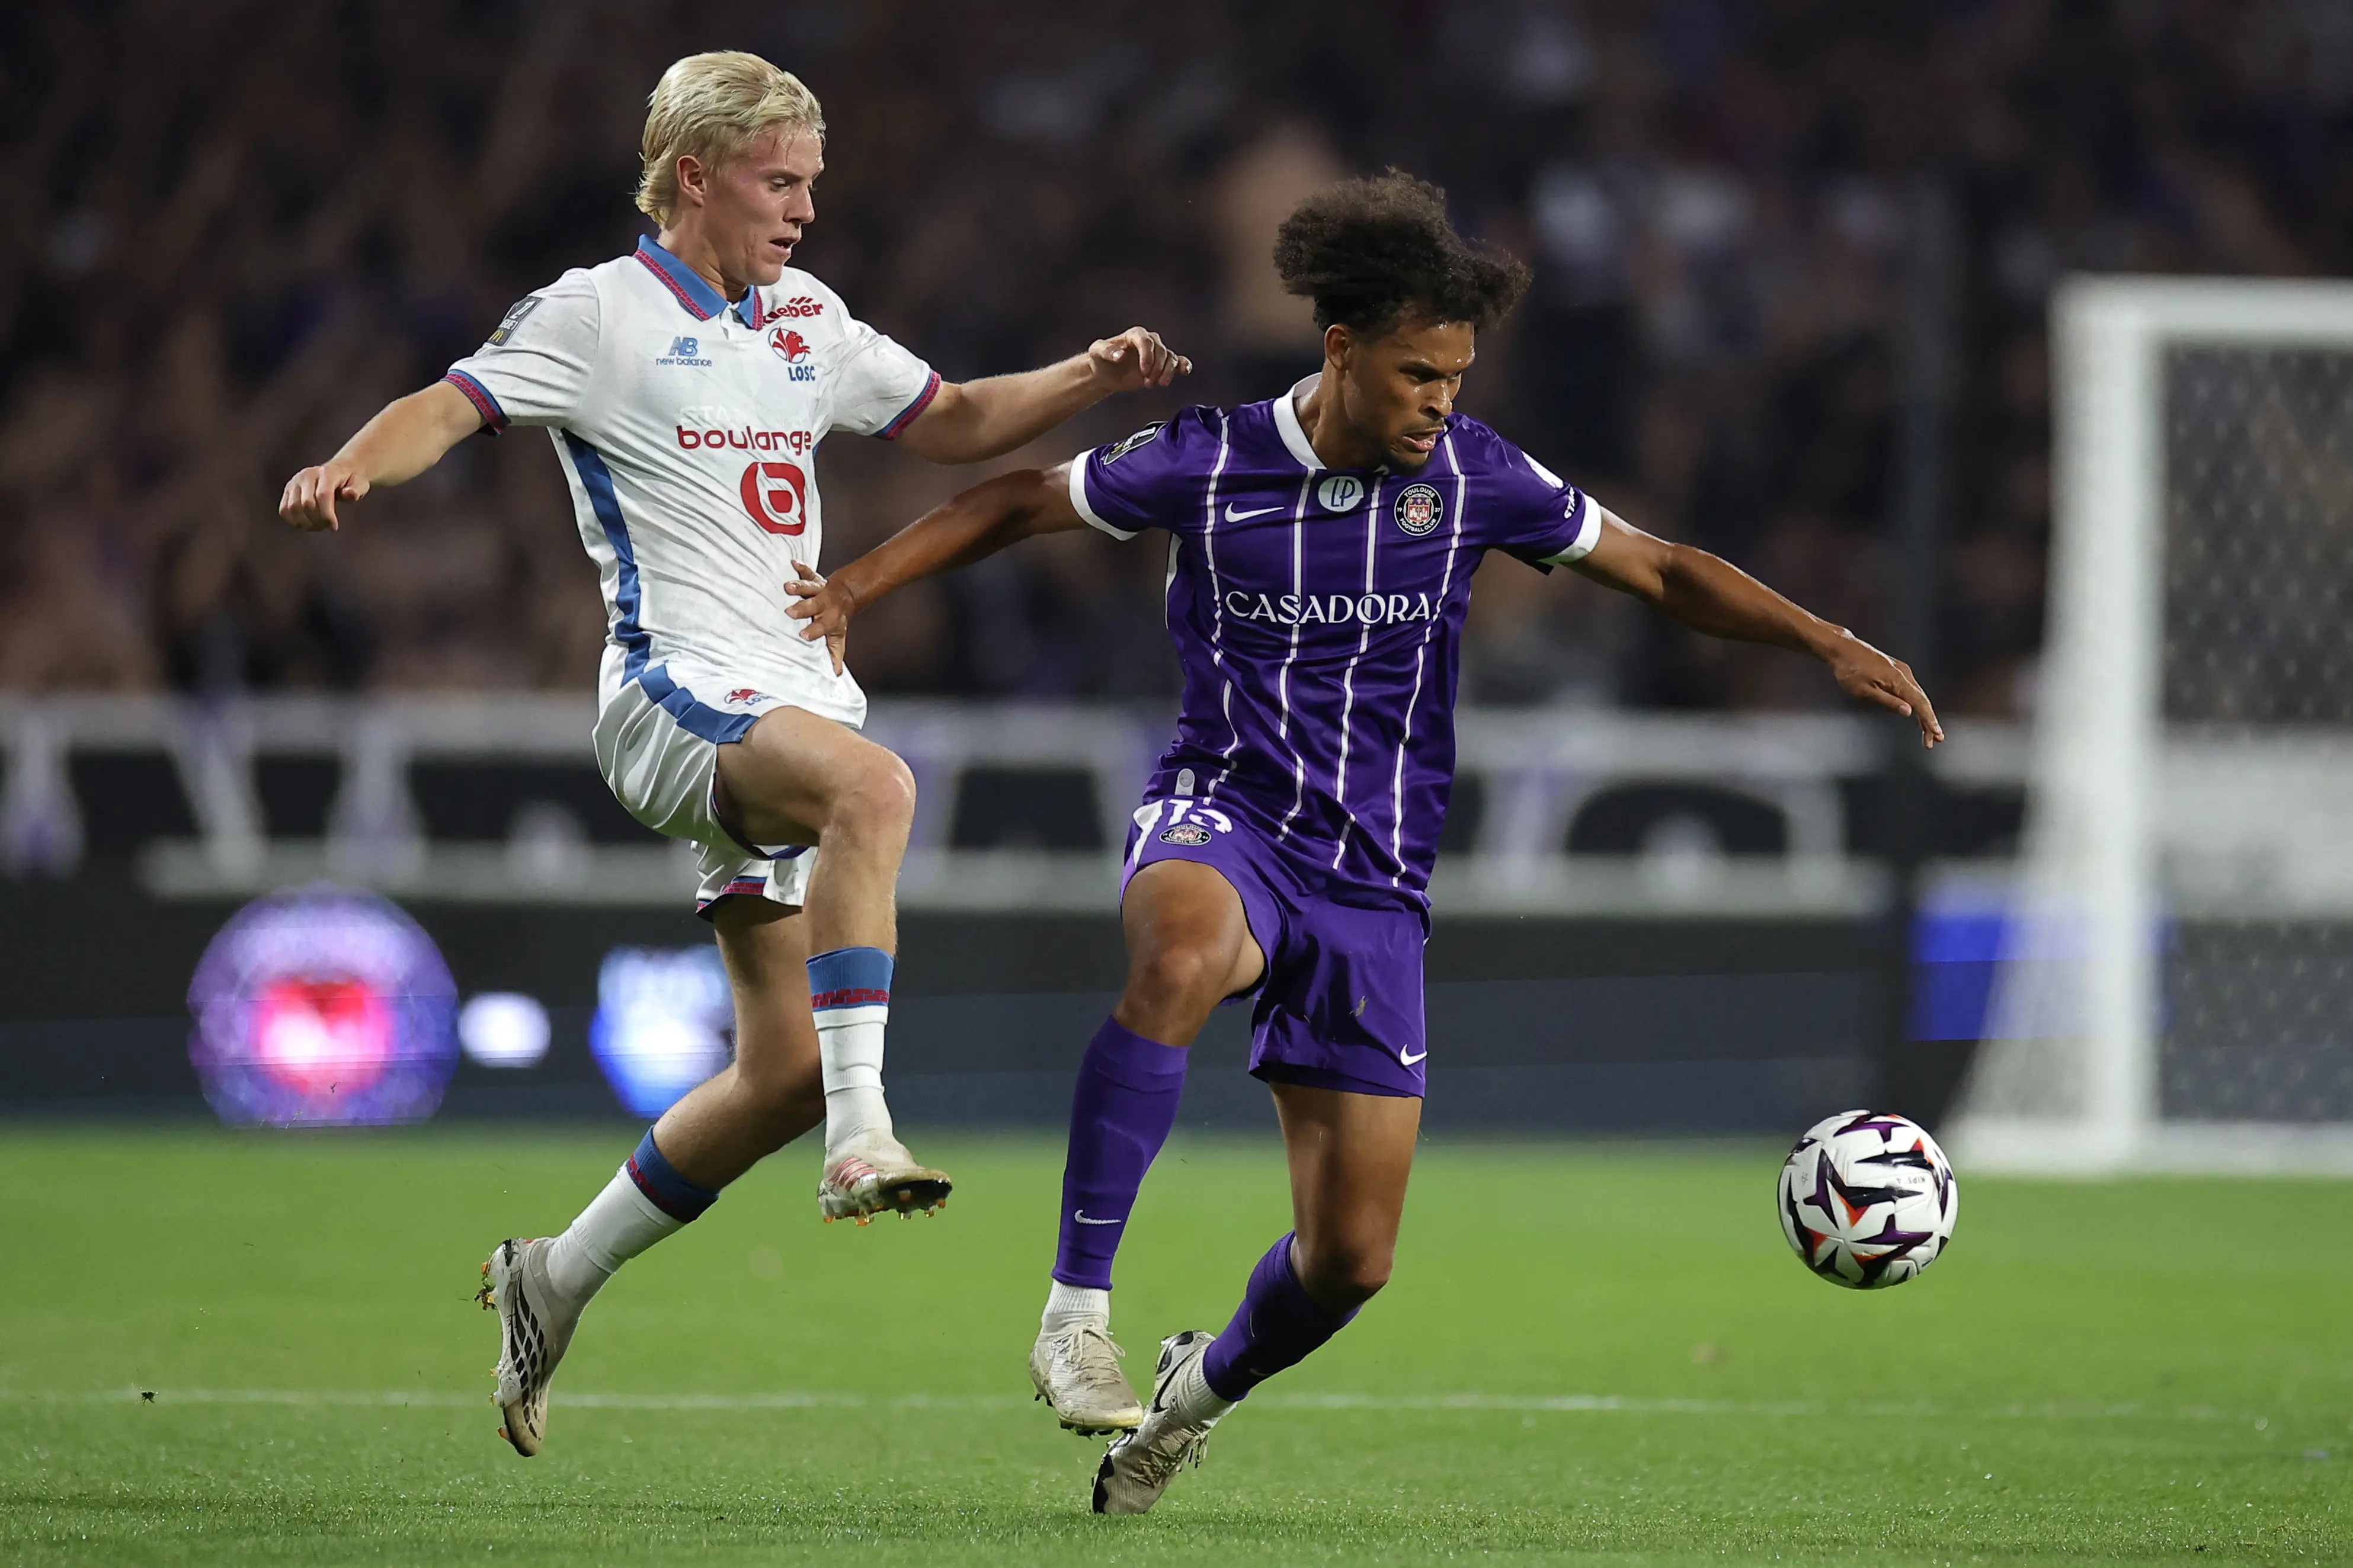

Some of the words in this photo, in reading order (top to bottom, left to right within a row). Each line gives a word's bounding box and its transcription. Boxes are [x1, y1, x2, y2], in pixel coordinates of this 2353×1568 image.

[668, 336, 697, 357] NB
[676, 356, 712, 367] balance
[787, 365, 815, 381] LOSC
[1331, 478, 1355, 506] LP
[1404, 487, 1435, 498] TOULOUSE
[1400, 518, 1424, 533] FOOTBALL
[1424, 518, 1436, 530] CLUB
[1225, 591, 1430, 624] CASADORA
